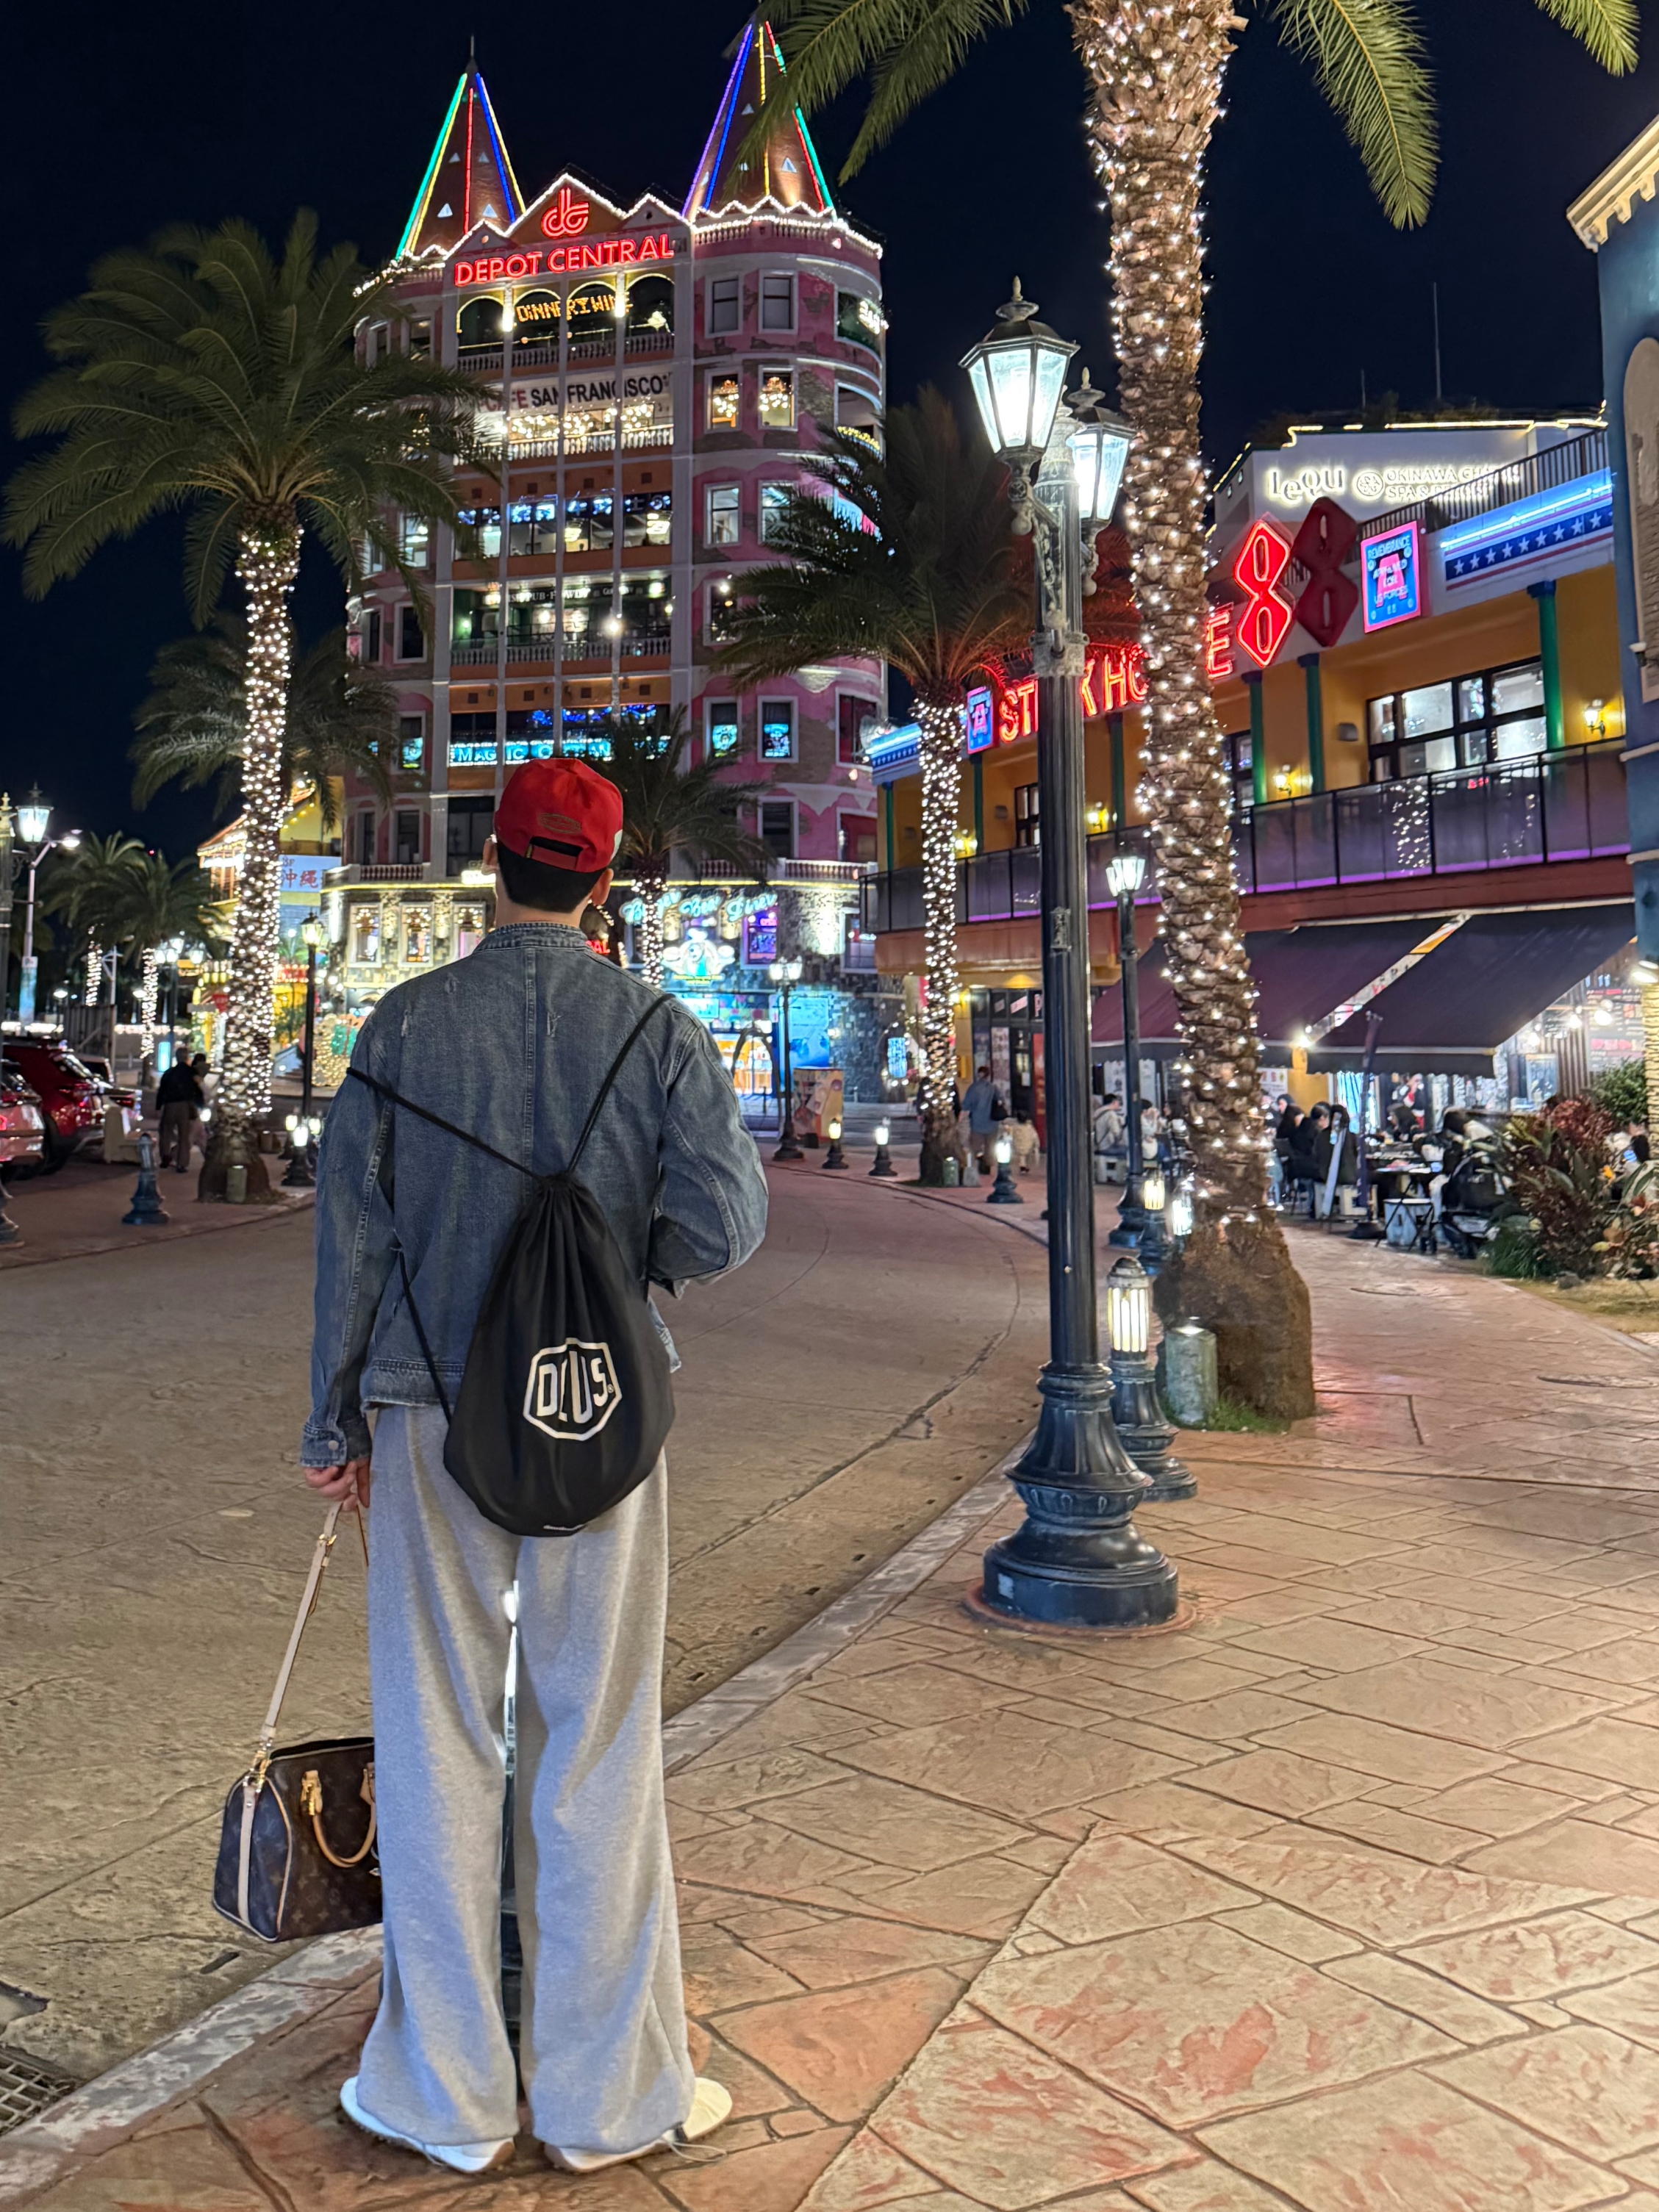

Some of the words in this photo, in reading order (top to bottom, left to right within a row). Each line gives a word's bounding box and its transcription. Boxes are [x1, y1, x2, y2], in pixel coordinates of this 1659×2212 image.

[454, 251, 543, 287] DEPOT
[548, 233, 675, 273] CENTRAL
[1386, 468, 1458, 482] OKINAWA
[1388, 485, 1416, 499] SPA
[999, 656, 1098, 744] STK
[1104, 609, 1234, 711] HOE
[458, 746, 525, 761] MAGIC
